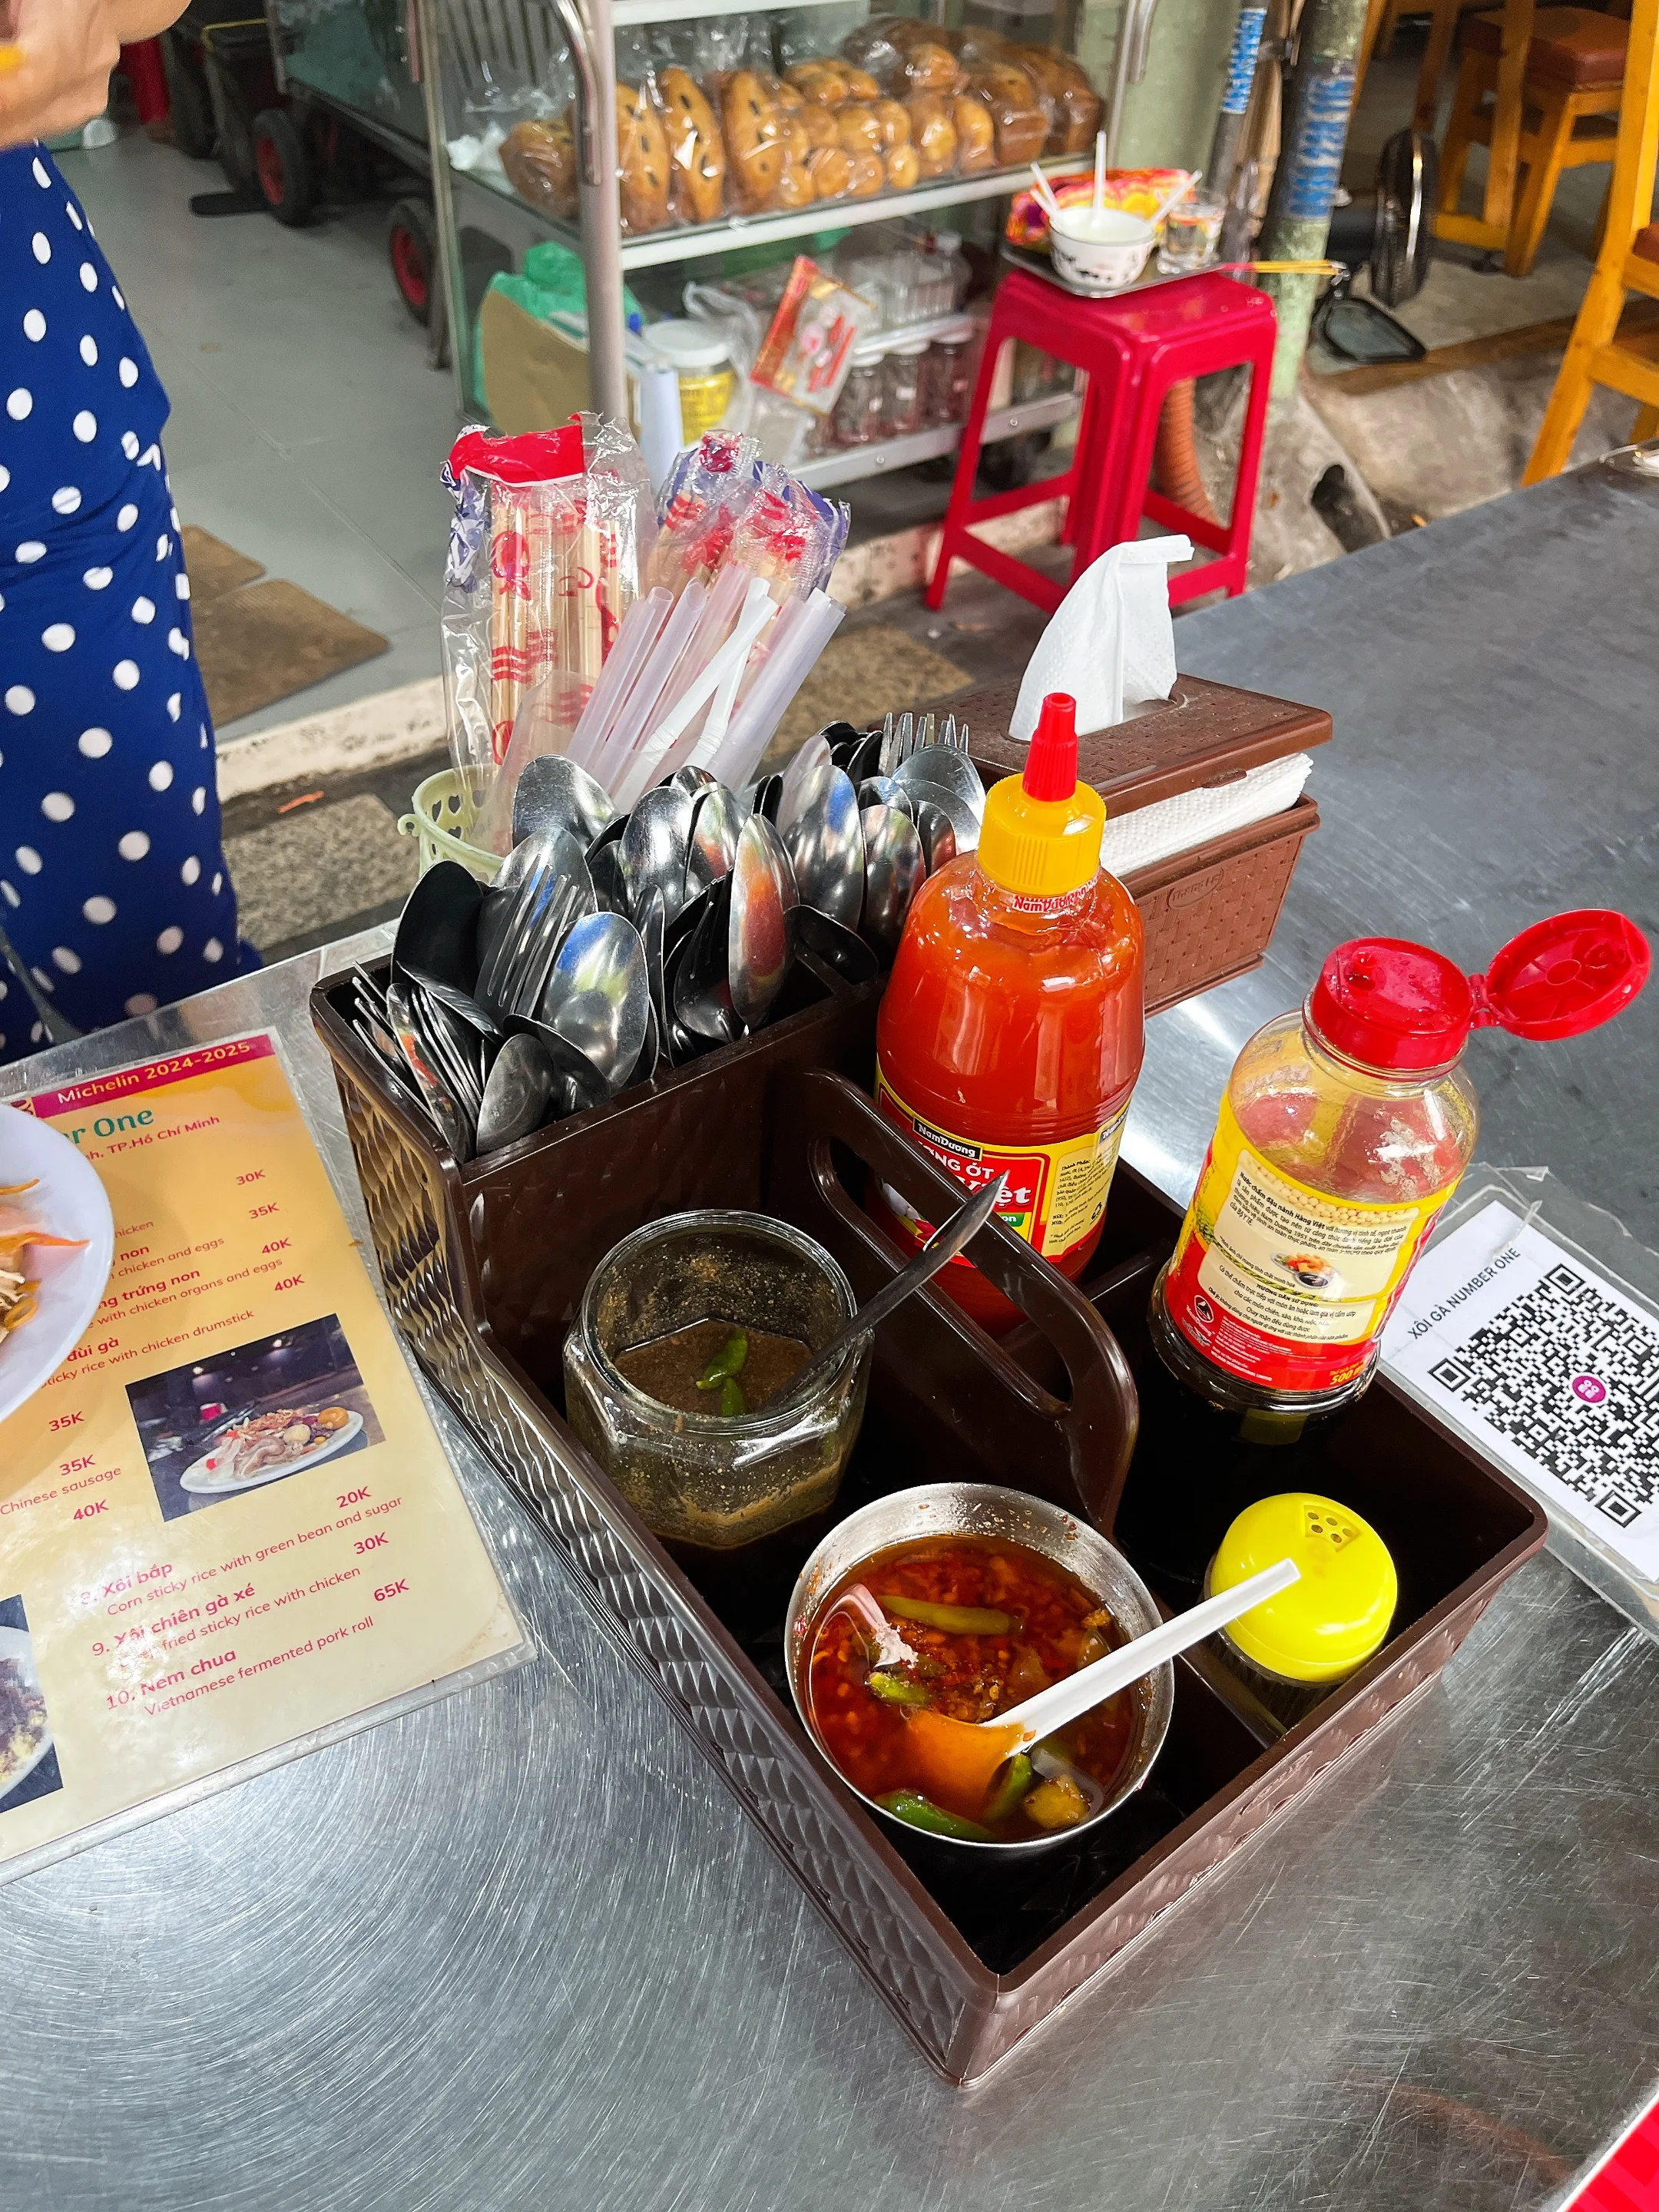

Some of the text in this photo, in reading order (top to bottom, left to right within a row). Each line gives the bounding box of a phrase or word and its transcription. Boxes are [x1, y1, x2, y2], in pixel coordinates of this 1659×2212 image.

[58, 1041, 251, 1104] Michelin 2024-2025
[94, 1109, 154, 1137] One
[157, 1126, 180, 1141] Chí
[185, 1116, 220, 1134] Minh
[918, 1123, 976, 1158] NamDương
[236, 1169, 266, 1185] 30K
[965, 1161, 994, 1180] ỚT
[249, 1202, 280, 1219] 35K
[1277, 1205, 1293, 1217] nành
[1294, 1213, 1312, 1225] Hàng
[1313, 1220, 1325, 1229] Việt
[118, 1257, 165, 1279] chicken
[168, 1247, 192, 1261] and
[194, 1237, 225, 1254] eggs
[120, 1245, 150, 1261] non
[262, 1237, 292, 1254] 40K
[97, 1310, 127, 1326] with
[130, 1293, 177, 1315] chicken
[180, 1280, 224, 1299] organs
[227, 1268, 250, 1283] and
[253, 1258, 283, 1275] eggs
[122, 1280, 167, 1301] trứng
[171, 1269, 200, 1286] non
[274, 1273, 305, 1291] 40K
[1407, 1247, 1521, 1339] XÔI GÀ NUMBER ONE
[81, 1360, 106, 1376] rice
[108, 1348, 138, 1364] with
[141, 1332, 190, 1353] chicken
[193, 1309, 255, 1337] drumstick
[98, 1337, 120, 1355] gà
[49, 1411, 84, 1432] 35K
[60, 1454, 96, 1475] 35K
[0, 1468, 121, 1515] Chinese sausage
[336, 1485, 372, 1508] 20K
[73, 1498, 109, 1520] 40K
[108, 1497, 402, 1615] Corn sticky rice with green bean and sugar
[353, 1531, 389, 1555] 30K
[102, 1575, 132, 1598] Xôi
[137, 1563, 173, 1584] bắp
[373, 1578, 410, 1601] 65K
[92, 1642, 111, 1657] 9.
[151, 1606, 200, 1634] chiên
[205, 1594, 230, 1615] gà
[233, 1582, 256, 1602] xé
[161, 1568, 361, 1651] fried sticky rice with chicken
[140, 1671, 185, 1696] Nem
[190, 1650, 237, 1676] chua
[144, 1615, 374, 1716] Vietnamese fermented pork roll
